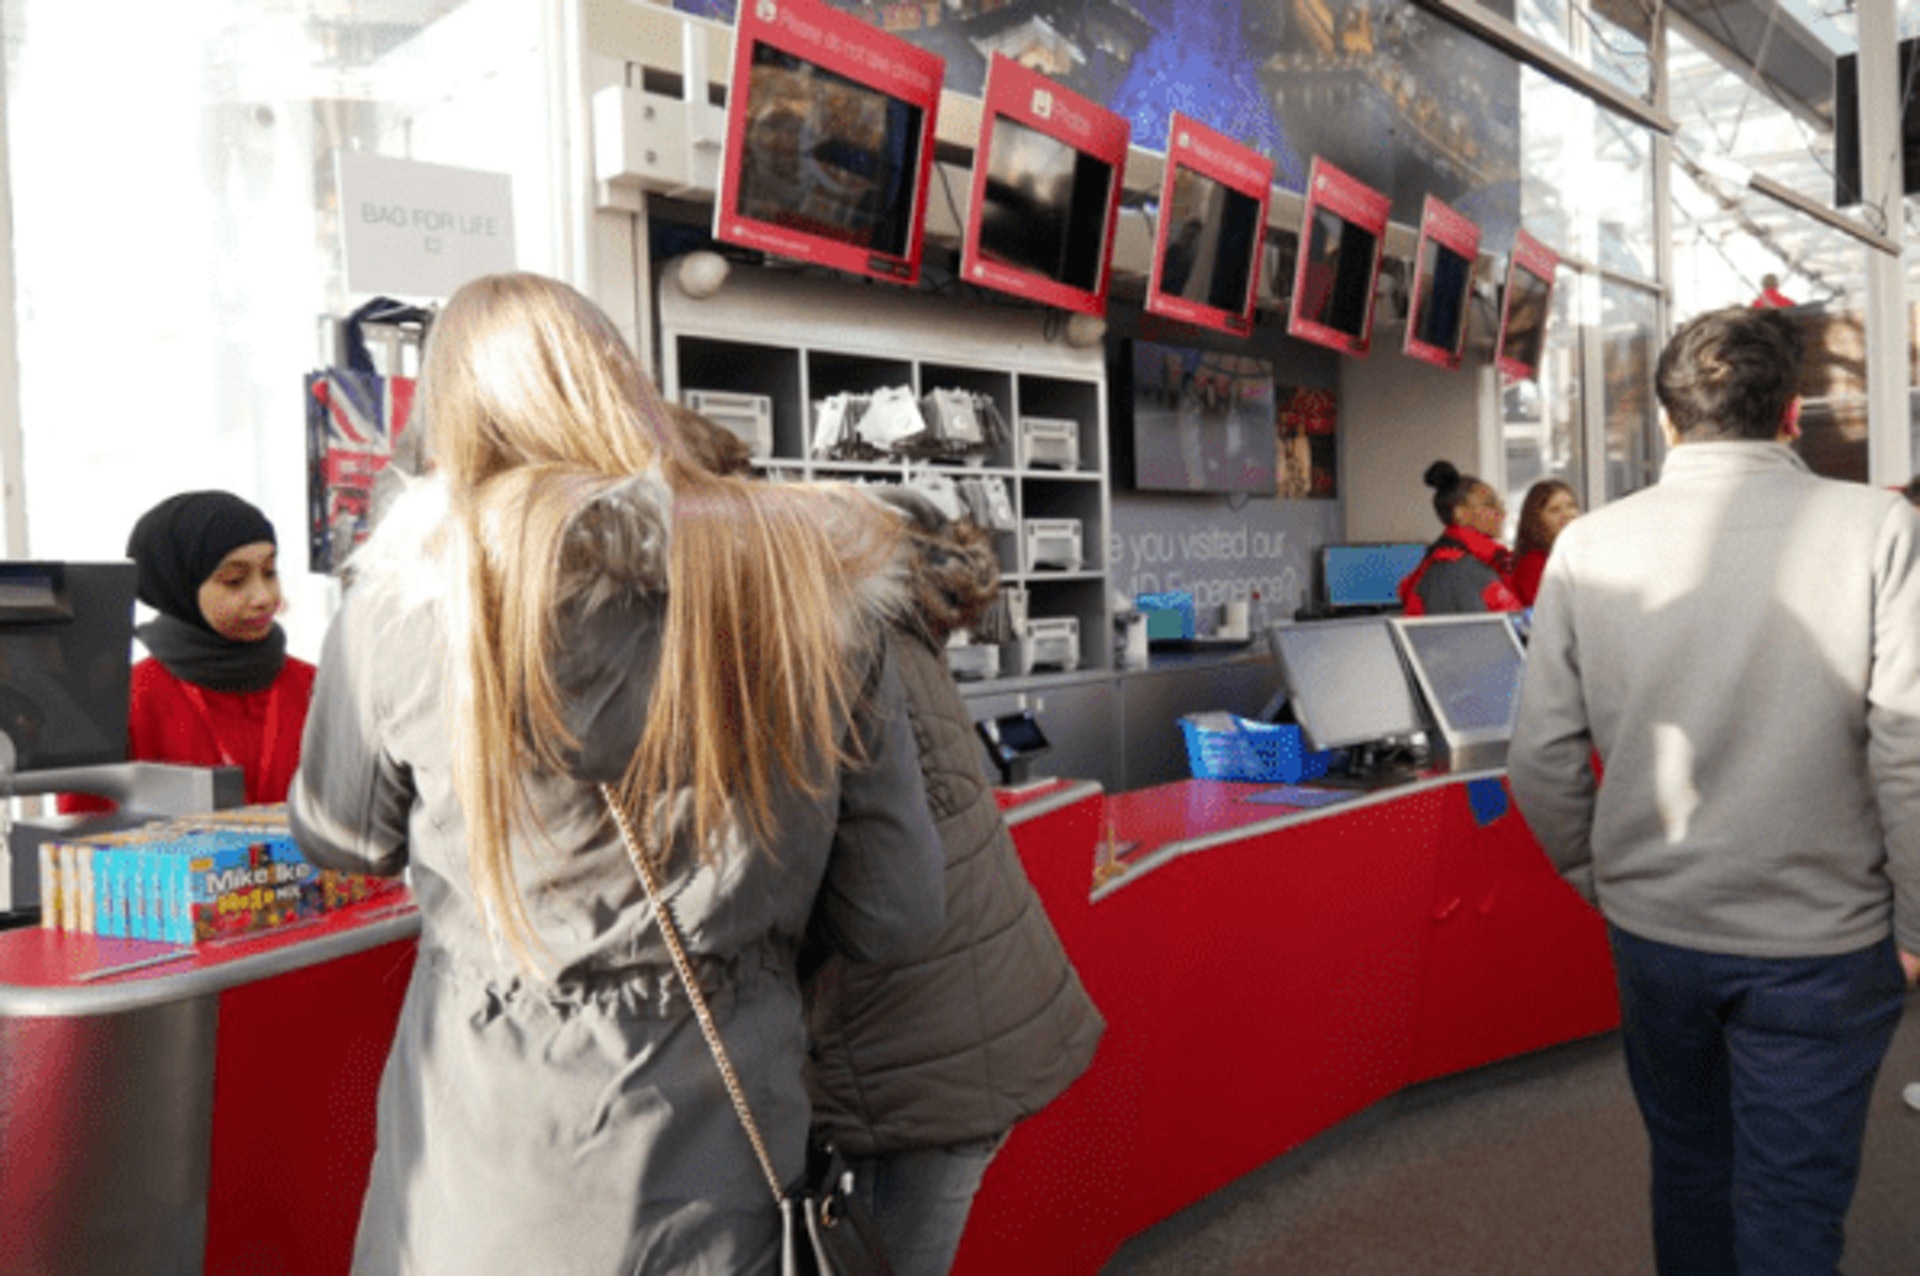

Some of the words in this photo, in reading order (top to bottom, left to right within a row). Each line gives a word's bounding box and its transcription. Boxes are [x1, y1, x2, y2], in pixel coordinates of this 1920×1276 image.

[361, 202, 407, 228] BAG
[412, 208, 455, 231] FOR
[460, 214, 498, 236] LIFE
[1129, 531, 1174, 572] you
[1178, 524, 1249, 561] visited
[1252, 530, 1287, 559] our
[205, 866, 269, 894] Mike
